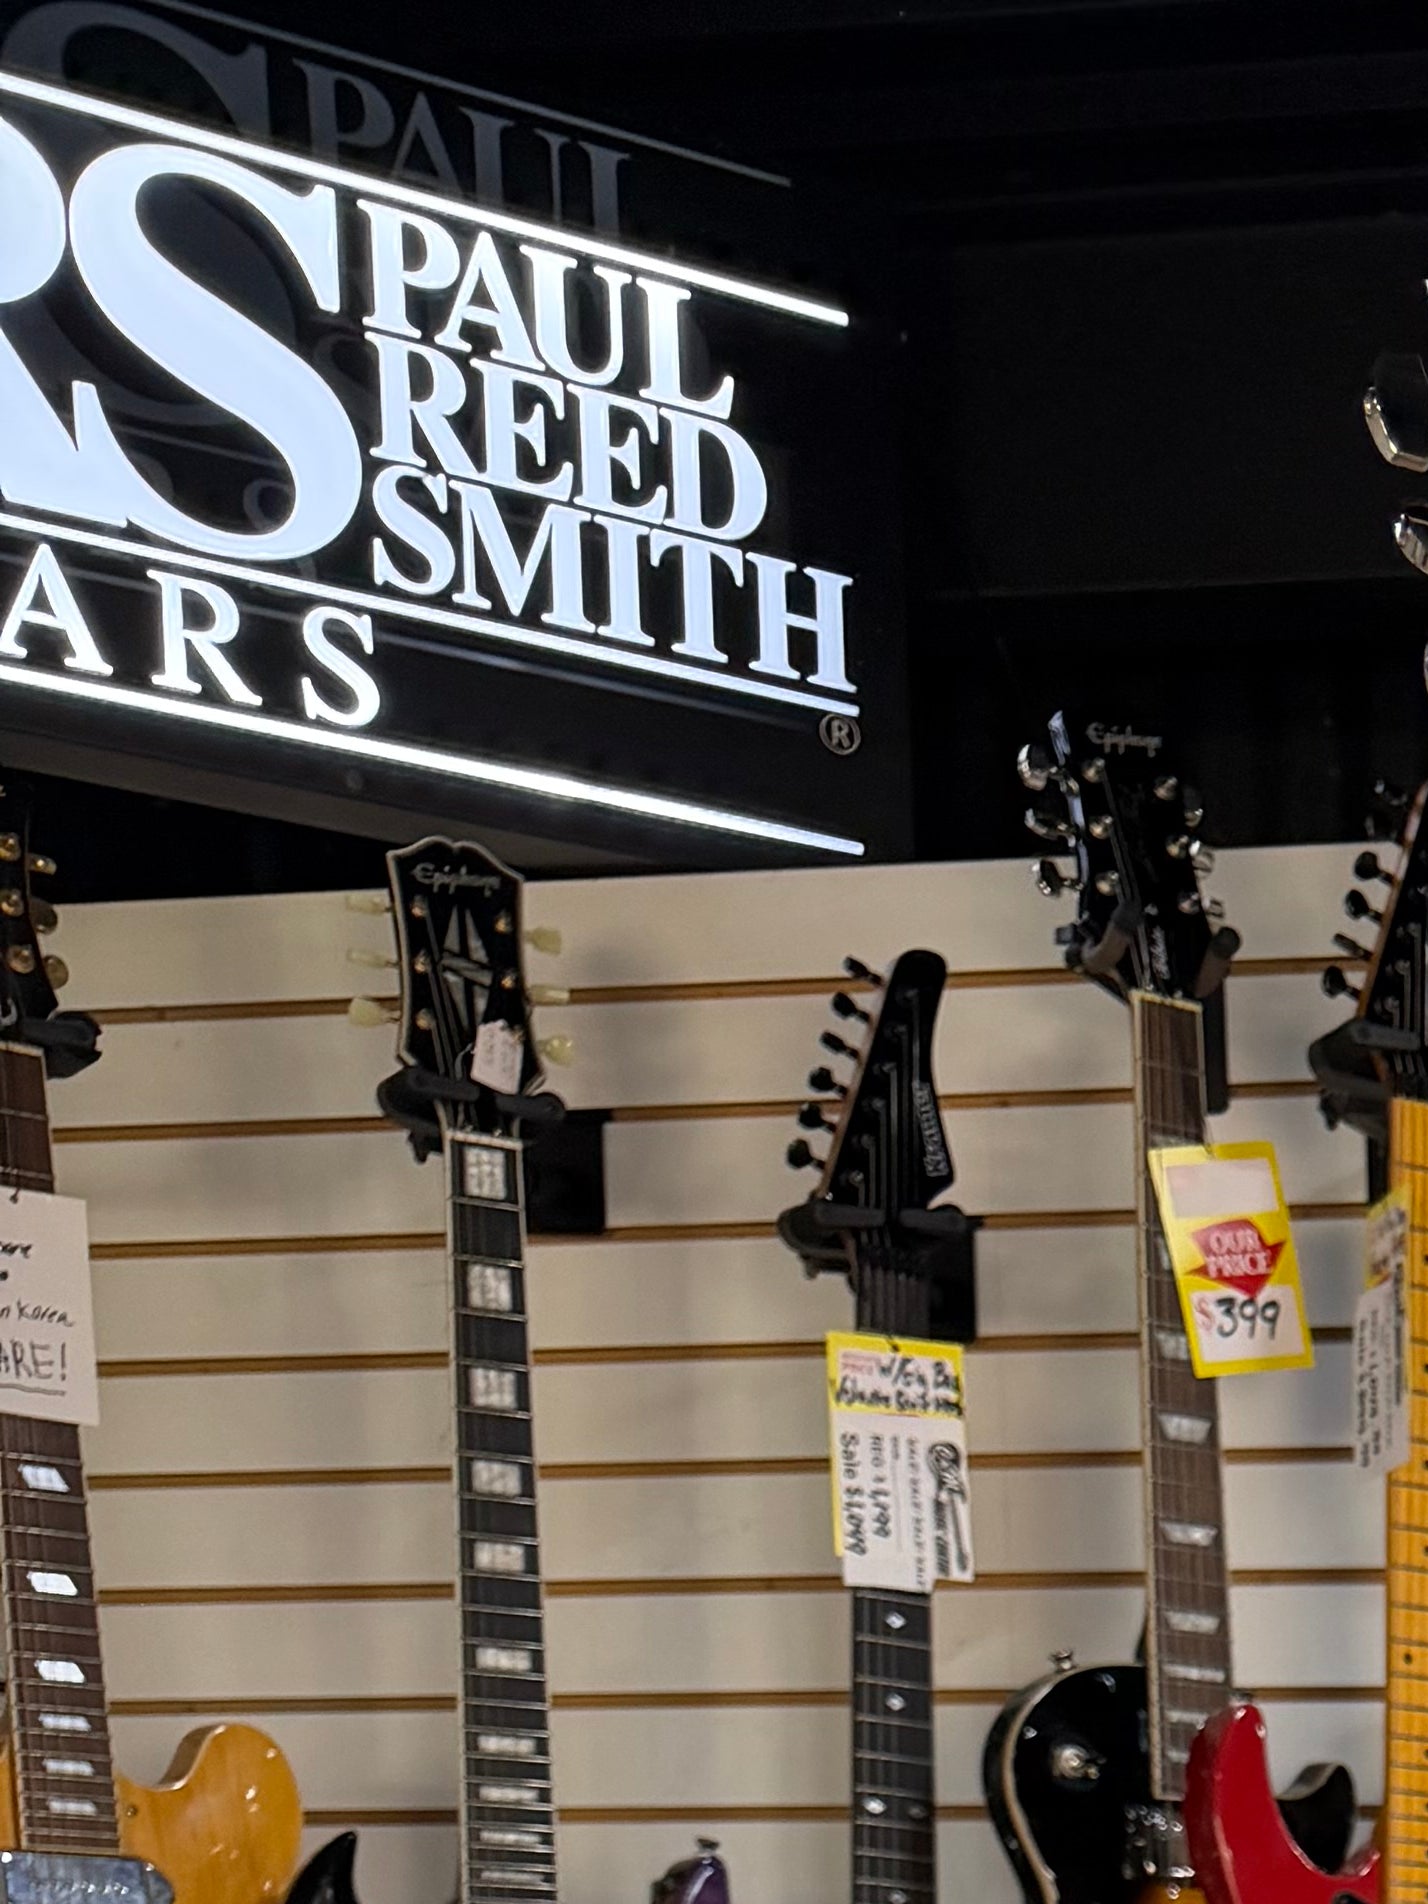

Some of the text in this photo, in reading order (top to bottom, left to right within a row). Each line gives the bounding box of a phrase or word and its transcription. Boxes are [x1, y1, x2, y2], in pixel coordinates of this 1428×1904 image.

[357, 198, 735, 419] PAUL
[364, 332, 768, 542] REED
[371, 464, 858, 695] SMITH
[1205, 1250, 1274, 1278] PRICE
[1209, 1228, 1262, 1252] OUR
[1195, 1297, 1280, 1340] $399
